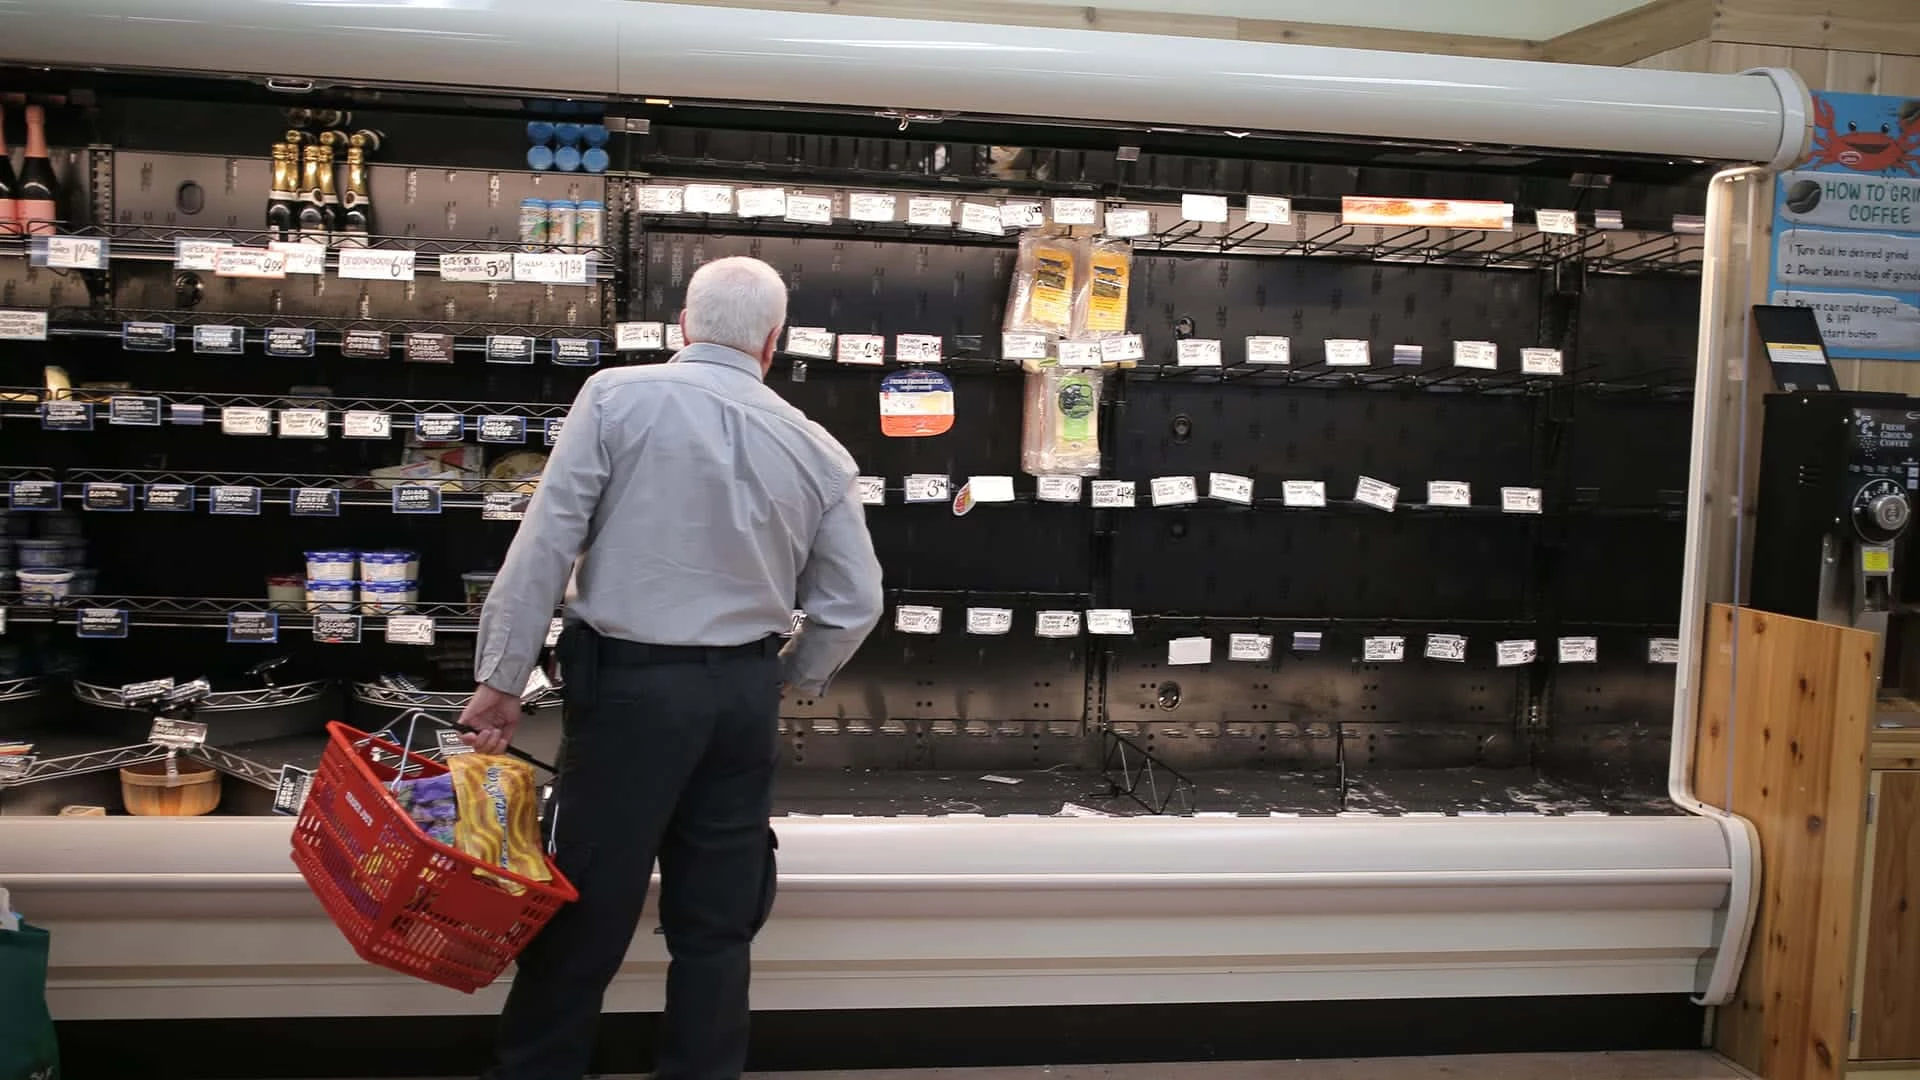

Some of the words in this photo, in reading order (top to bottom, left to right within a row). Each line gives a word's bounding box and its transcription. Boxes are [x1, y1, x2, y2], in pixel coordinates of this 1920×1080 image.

[1825, 181, 1861, 200] HOW
[1866, 184, 1886, 202] TO
[1849, 204, 1911, 224] COFFEE
[1795, 244, 1816, 257] Turn
[1818, 246, 1836, 257] dial
[1838, 247, 1848, 257] to
[1849, 248, 1882, 259] desired
[1884, 249, 1909, 262] grind
[1798, 264, 1821, 276] Pour
[1823, 266, 1850, 277] beans
[1853, 269, 1862, 278] in
[1863, 268, 1879, 283] top
[1823, 303, 1841, 312] can
[1842, 303, 1869, 313] under
[1871, 304, 1897, 317] spout
[1822, 330, 1846, 338] start
[1847, 331, 1877, 339] button
[318, 622, 357, 630] PECORINO
